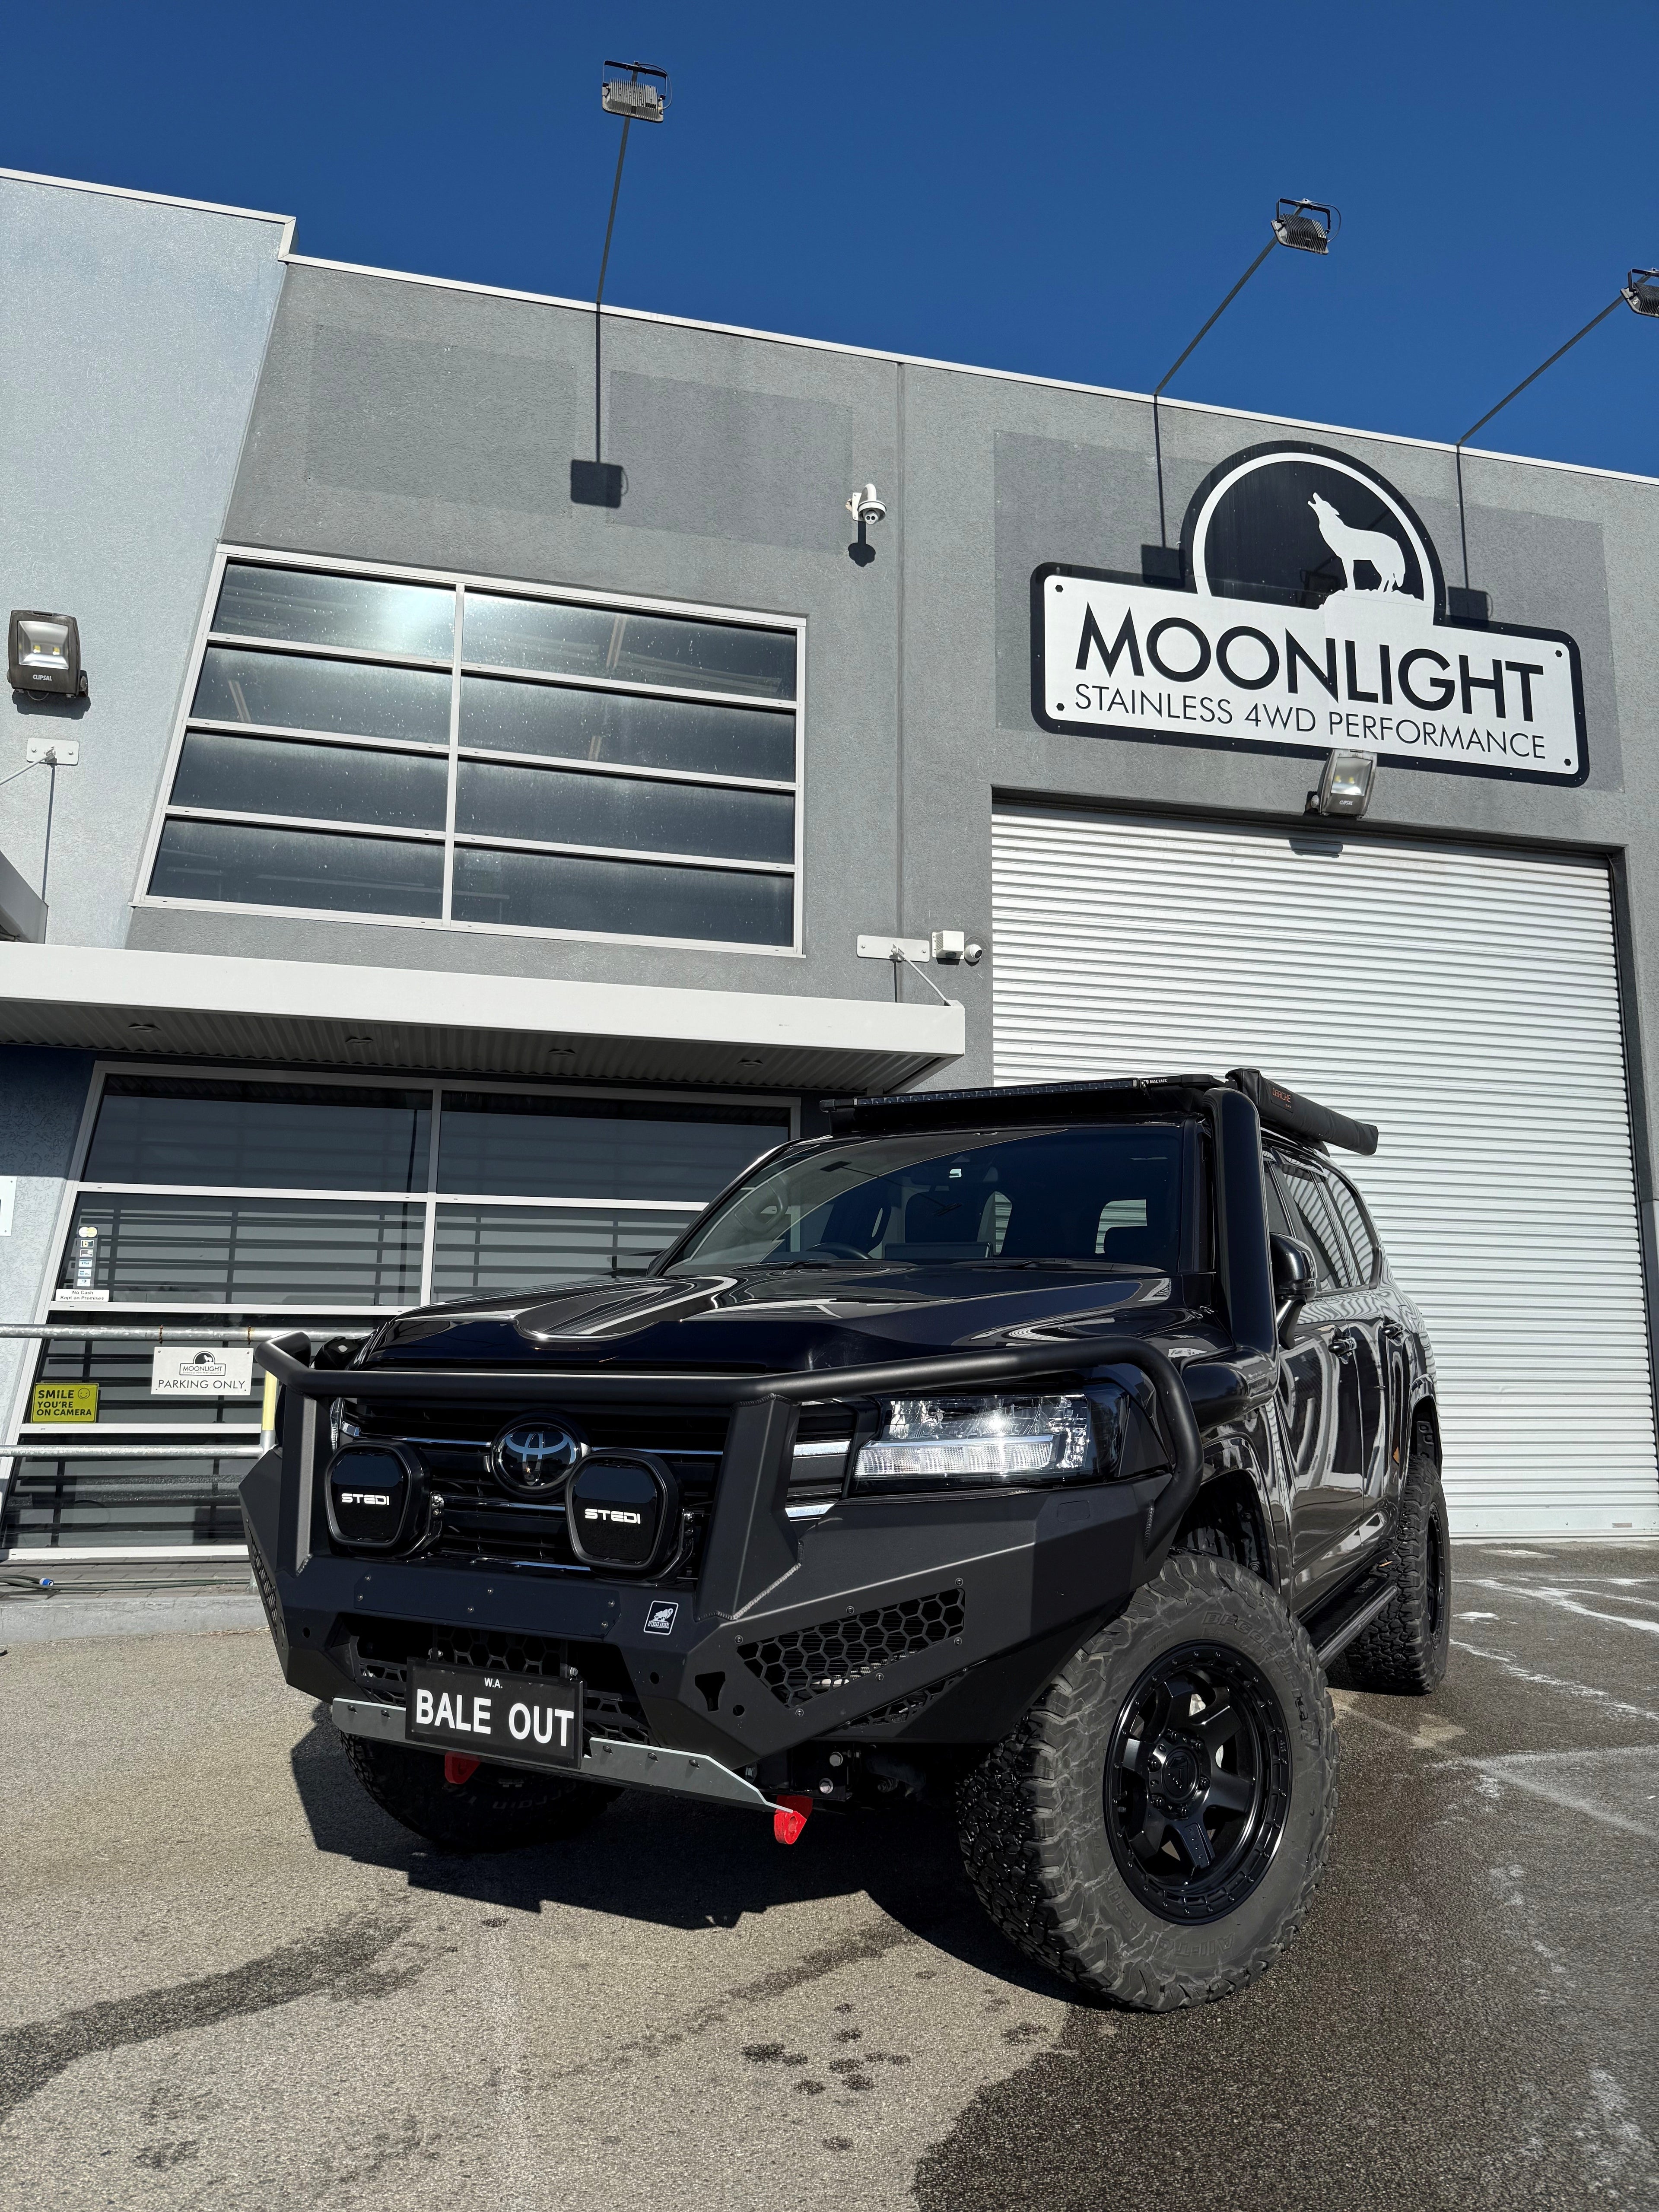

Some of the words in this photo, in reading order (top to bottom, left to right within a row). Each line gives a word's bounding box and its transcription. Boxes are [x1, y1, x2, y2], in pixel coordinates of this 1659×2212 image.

[1075, 602, 1544, 722] MOONLIGHT
[1075, 683, 1233, 724] STAINLESS
[1244, 703, 1316, 732] 4WD
[1329, 711, 1545, 759] PERFORMANCE
[158, 1379, 209, 1389] PARKING
[213, 1380, 245, 1389] ONLY
[38, 1390, 74, 1399] SMILE
[341, 1493, 390, 1506] STEDI
[585, 1508, 641, 1524] STEDI
[416, 1689, 491, 1735] BALE
[509, 1703, 574, 1747] OUT
